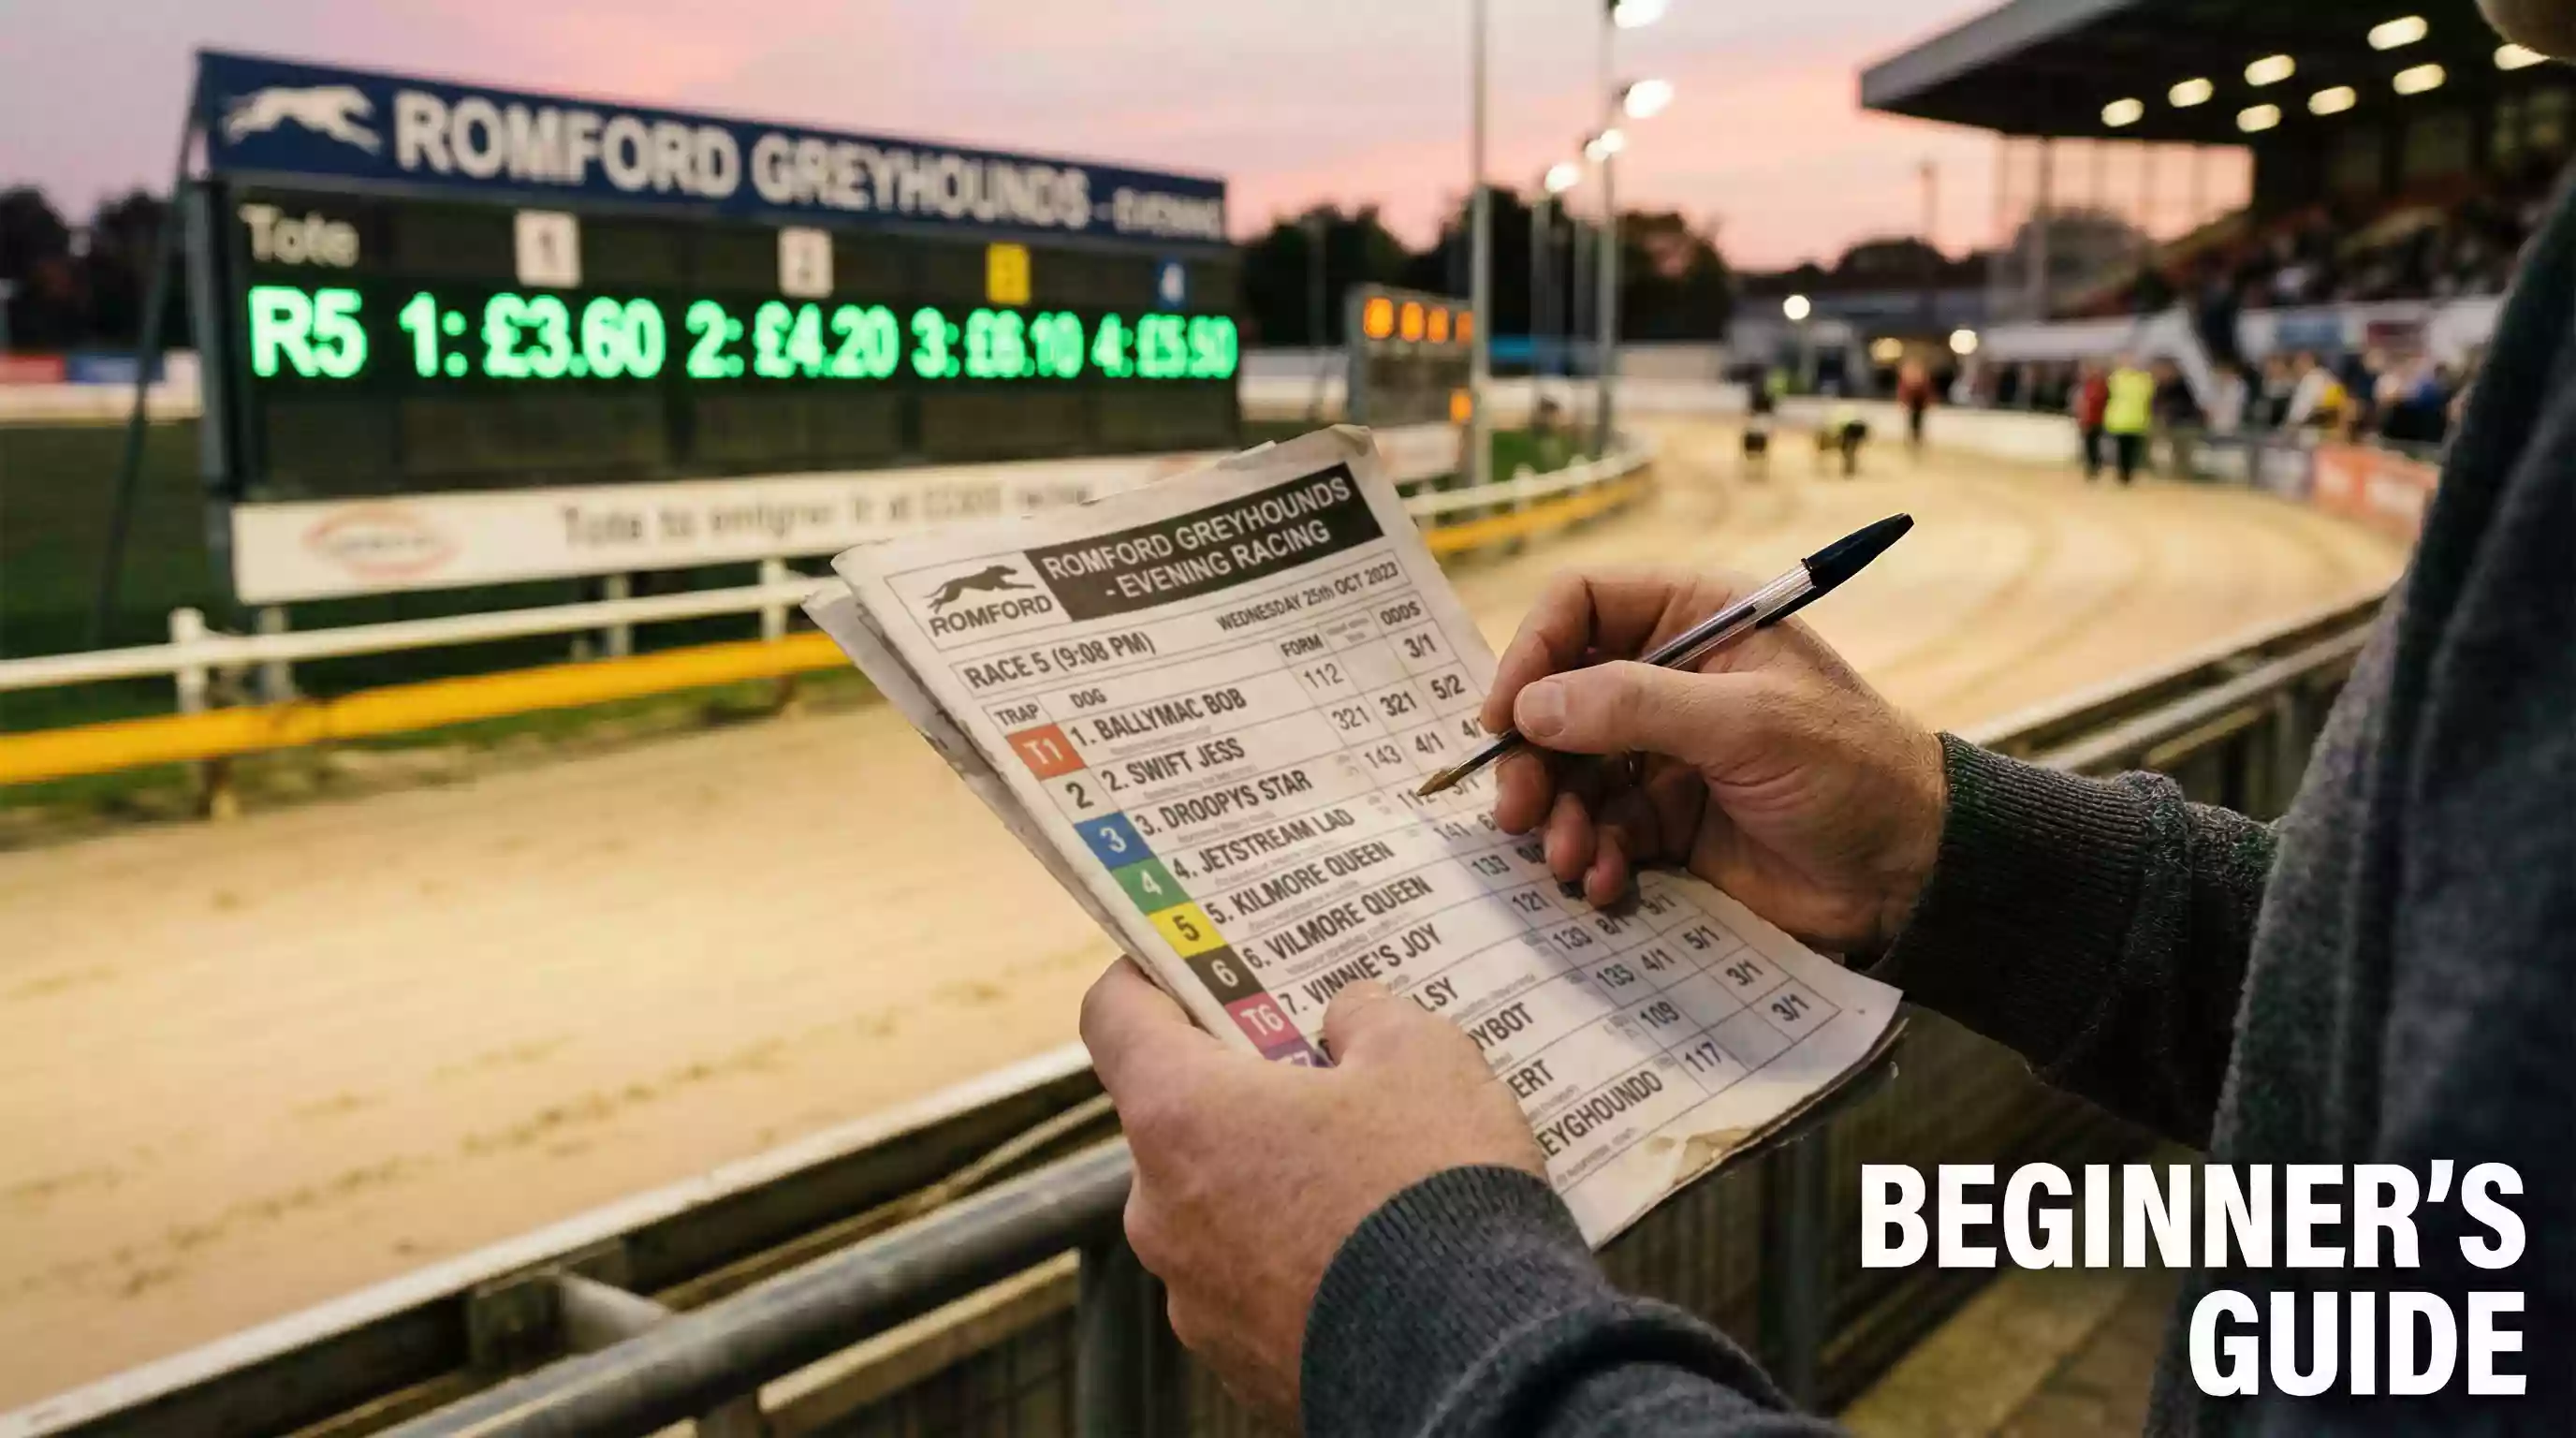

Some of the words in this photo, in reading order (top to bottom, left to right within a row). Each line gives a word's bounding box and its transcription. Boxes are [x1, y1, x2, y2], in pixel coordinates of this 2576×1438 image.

[393, 90, 741, 198] ROMFORD
[752, 132, 1090, 230] GREYHOUNDS
[248, 286, 368, 378] R5
[399, 292, 468, 377] 1:
[481, 292, 666, 378] £3.60
[686, 301, 744, 378] 2:
[754, 301, 900, 378] £4.20
[910, 307, 960, 377] 3:
[1090, 314, 1134, 378] 4:
[1041, 533, 1173, 580] ROMFORD
[1176, 477, 1351, 550] GREYHOUNDS
[1116, 550, 1231, 598] EVENING
[1231, 520, 1330, 569] RACING
[1216, 592, 1302, 631] WEDNESDAY
[1335, 574, 1363, 595] OCT
[1367, 562, 1398, 586] 2023
[929, 594, 1052, 637] ROMFORD
[1381, 601, 1421, 626] ODDS
[1281, 634, 1324, 658] FORM
[1404, 633, 1438, 658] 3/1
[963, 655, 1033, 690] RACE
[1032, 652, 1052, 674] 5
[1051, 639, 1109, 671] (9:08
[1108, 631, 1156, 656] PM)
[1304, 663, 1344, 689] 112
[1430, 674, 1466, 700] 5/2
[1069, 688, 1107, 710] DOG
[1380, 691, 1418, 717] 321
[993, 704, 1039, 727] TRAP
[1070, 726, 1096, 747] 1.
[1093, 698, 1204, 742] BALLYMAC
[1202, 687, 1247, 713] BOB
[1332, 705, 1370, 730] 321
[1022, 736, 1064, 765] T1
[1364, 744, 1402, 770] 143
[1414, 731, 1444, 755] 4/1
[1101, 770, 1130, 792] 2.
[1126, 750, 1193, 785] SWIFT
[1197, 737, 1245, 768] JESS
[1066, 782, 1094, 810] 2
[1134, 814, 1163, 837] 3.
[1158, 788, 1259, 829] DROOPYS
[1257, 770, 1314, 800] STAR
[1100, 826, 1127, 854] 3
[1173, 858, 1198, 880] 4.
[1198, 819, 1315, 874] JETSTREAM
[1310, 808, 1355, 837] LAD
[1140, 869, 1163, 896] 4
[1205, 902, 1234, 925] 5.
[1230, 862, 1329, 917] KILMORE
[1324, 841, 1396, 878] QUEEN
[1512, 890, 1551, 913] 121
[1172, 914, 1201, 942] 5
[1242, 946, 1271, 970] 6.
[1265, 902, 1366, 961] VILMORE
[1360, 874, 1434, 915] QUEEN
[1682, 925, 1720, 950] 5/1
[1211, 960, 1238, 988] 6
[1278, 992, 1308, 1016] 7.
[1303, 944, 1402, 1005] VINNIE'S
[1399, 922, 1442, 959] JOY
[1641, 948, 1676, 971] 4/1
[1725, 958, 1764, 987] 3/1
[1239, 1004, 1284, 1036] T6
[1685, 1041, 1722, 1073] 117
[1507, 1059, 1556, 1099] ERT
[1536, 1070, 1663, 1161] EYGHOUNDO
